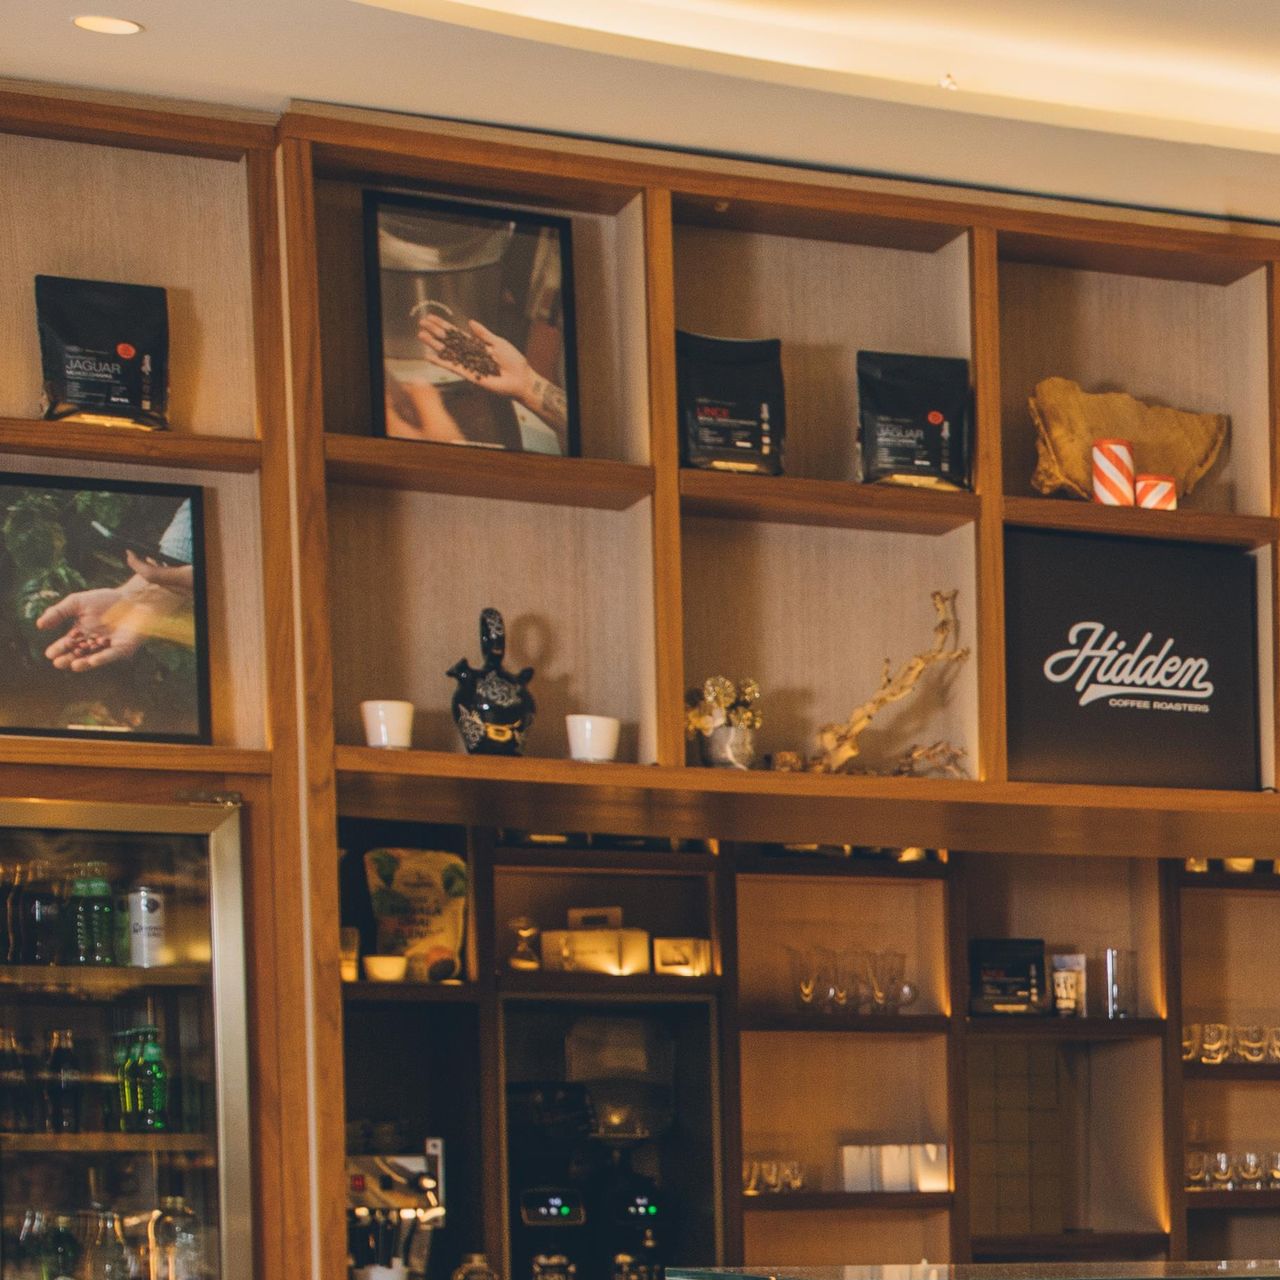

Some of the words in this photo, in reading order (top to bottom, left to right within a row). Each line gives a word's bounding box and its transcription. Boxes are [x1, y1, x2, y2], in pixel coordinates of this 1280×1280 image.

[65, 359, 122, 374] JAGUAR
[1044, 621, 1214, 706] Hidden
[1108, 698, 1151, 710] COFFEE
[1152, 700, 1210, 713] ROASTERS
